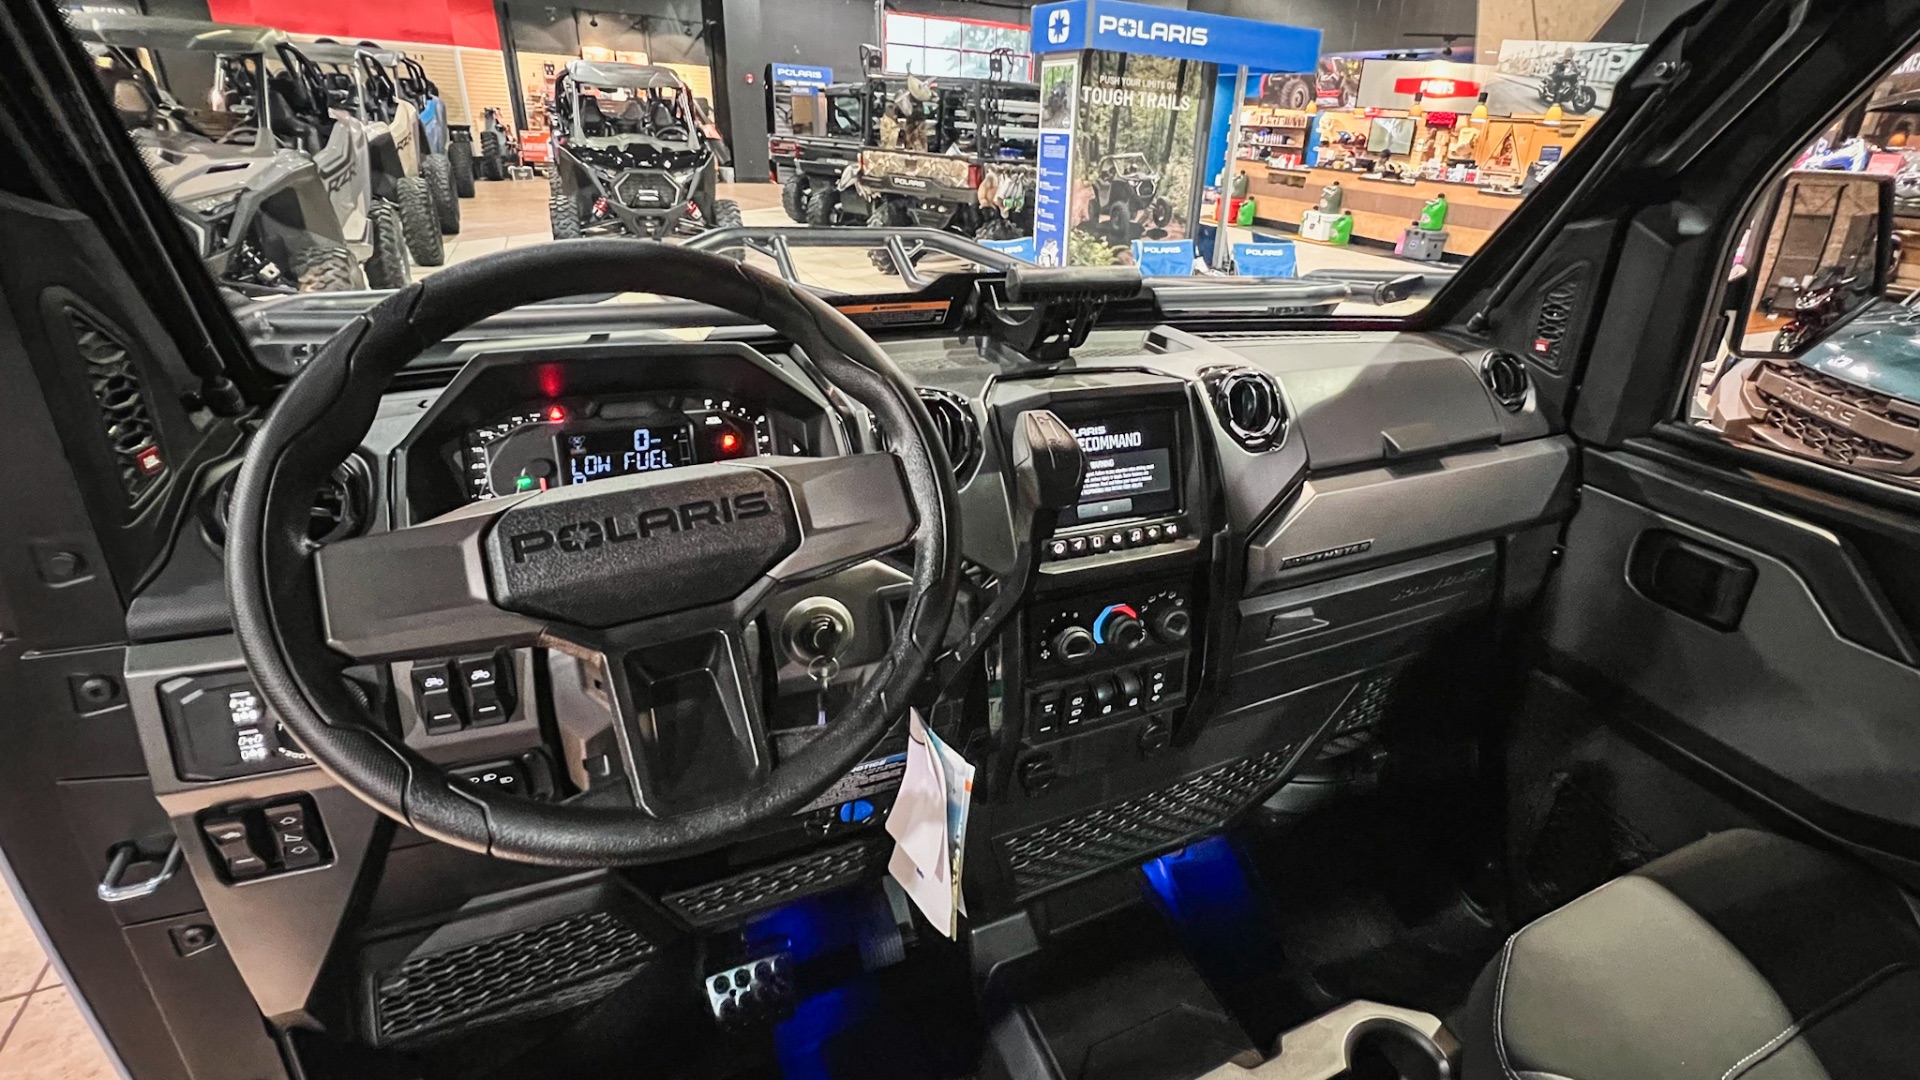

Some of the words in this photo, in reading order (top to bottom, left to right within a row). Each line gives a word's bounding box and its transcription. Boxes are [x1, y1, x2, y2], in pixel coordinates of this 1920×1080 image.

[1099, 15, 1209, 46] POLARIS
[777, 68, 823, 79] POLARIS
[1099, 75, 1120, 85] PUSH
[1121, 77, 1140, 87] YOUR
[1142, 79, 1165, 89] LIMITS
[1167, 82, 1177, 90] ON
[1081, 85, 1134, 107] TOUGH
[1137, 92, 1191, 112] TRAILS
[894, 177, 926, 188] POLARIS
[1144, 246, 1181, 254] POLARIS
[571, 455, 611, 476] LOW
[623, 449, 673, 470] FUEL
[510, 491, 774, 563] POLARIS
